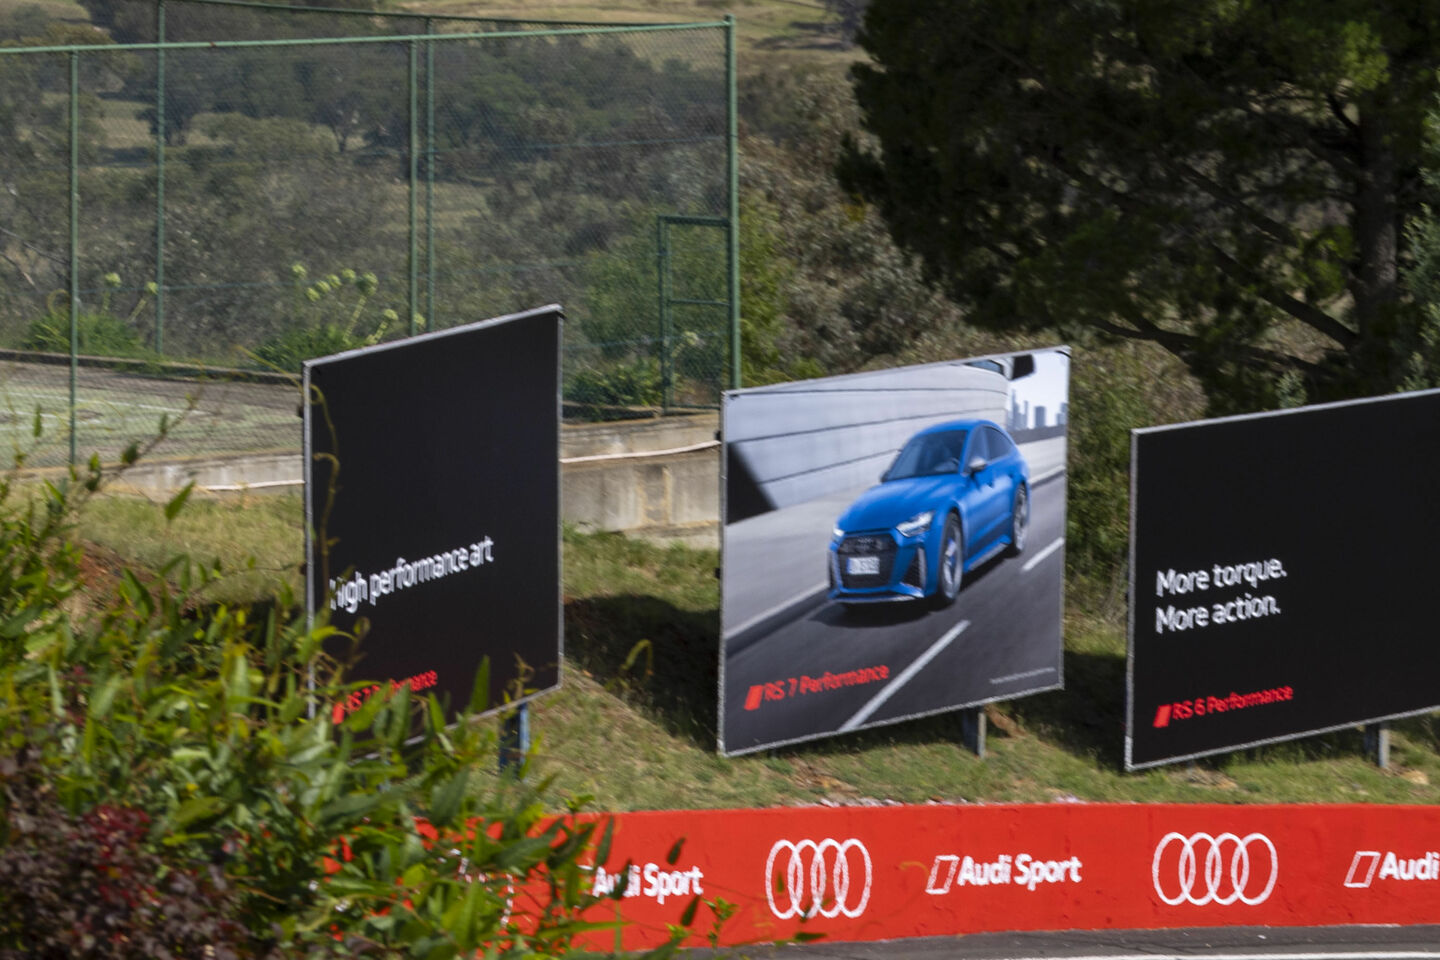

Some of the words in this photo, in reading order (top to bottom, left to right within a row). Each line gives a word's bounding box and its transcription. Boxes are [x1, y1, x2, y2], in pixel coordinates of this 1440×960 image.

[369, 547, 469, 606] performance
[469, 535, 494, 567] art
[1156, 568, 1210, 597] More
[1212, 558, 1287, 588] torque.
[1155, 605, 1210, 634] More
[1212, 592, 1281, 624] action.
[764, 680, 786, 701] RS
[788, 677, 798, 698] 7
[799, 664, 890, 695] Performance
[1172, 701, 1193, 720] RS
[1194, 698, 1206, 716] 6
[1207, 685, 1293, 714] Performance
[643, 862, 704, 905] Sport
[957, 854, 1012, 886] Audi
[1013, 853, 1083, 892] Sport
[1378, 851, 1440, 880] Audi
